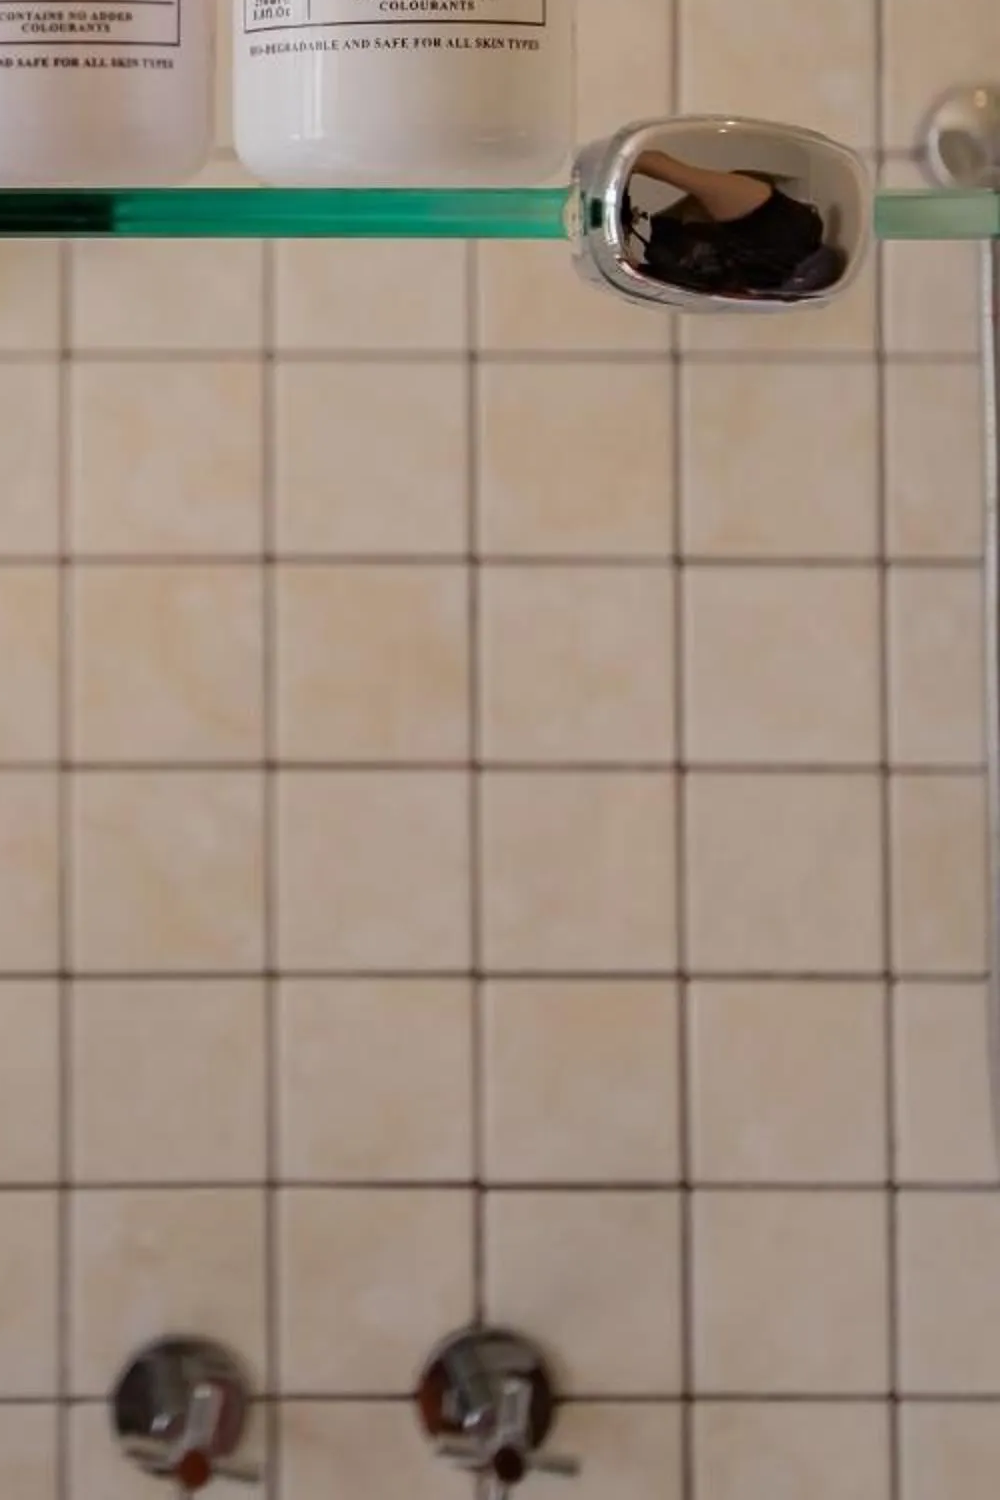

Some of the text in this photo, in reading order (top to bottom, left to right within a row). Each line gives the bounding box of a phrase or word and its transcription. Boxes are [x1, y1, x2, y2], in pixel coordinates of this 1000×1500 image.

[378, 0, 477, 12] COLOURANTS
[343, 38, 370, 51] AND
[374, 37, 407, 50] SAFE
[413, 37, 442, 49] FOR
[446, 37, 471, 49] ALL
[474, 37, 506, 50] SKIN
